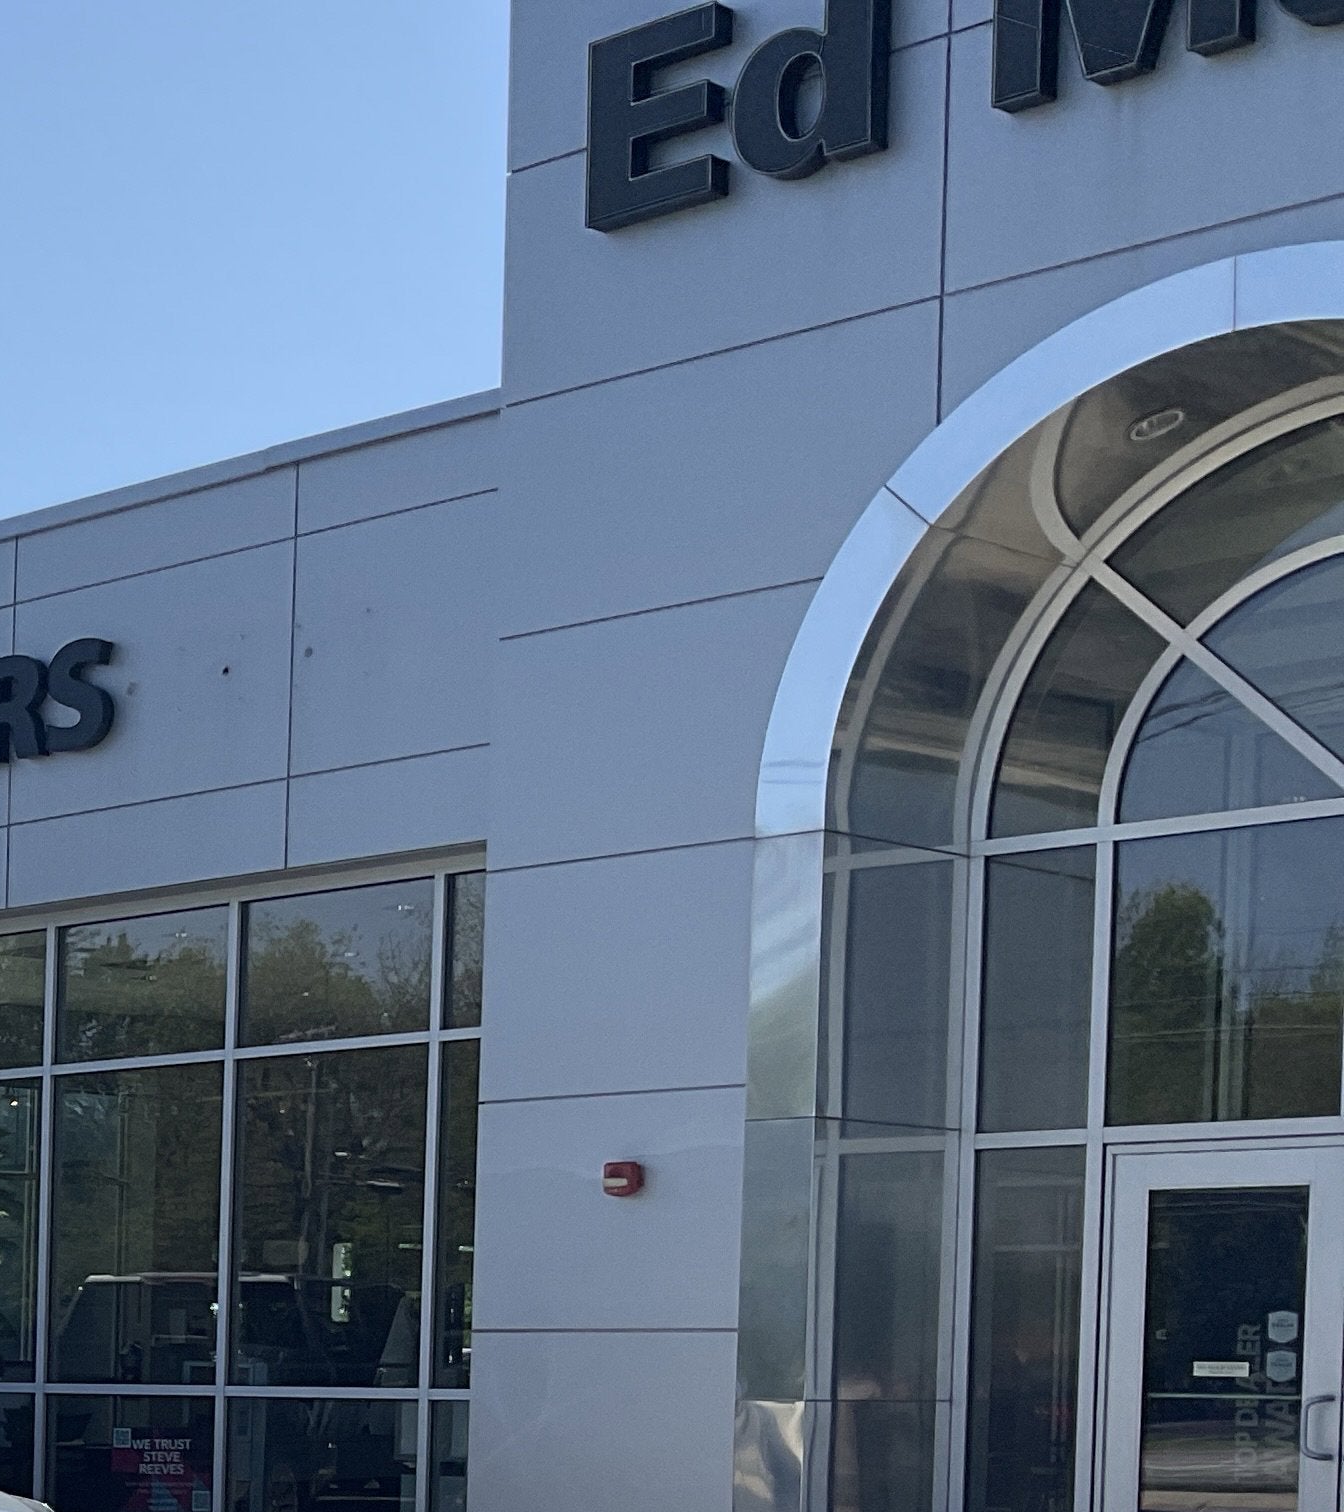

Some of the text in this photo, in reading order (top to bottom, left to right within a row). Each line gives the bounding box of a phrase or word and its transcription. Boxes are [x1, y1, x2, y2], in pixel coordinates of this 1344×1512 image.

[585, 0, 891, 232] Ed
[132, 1438, 192, 1450] WE TRUST
[143, 1451, 181, 1462] STEVE
[139, 1463, 185, 1475] REEVES
